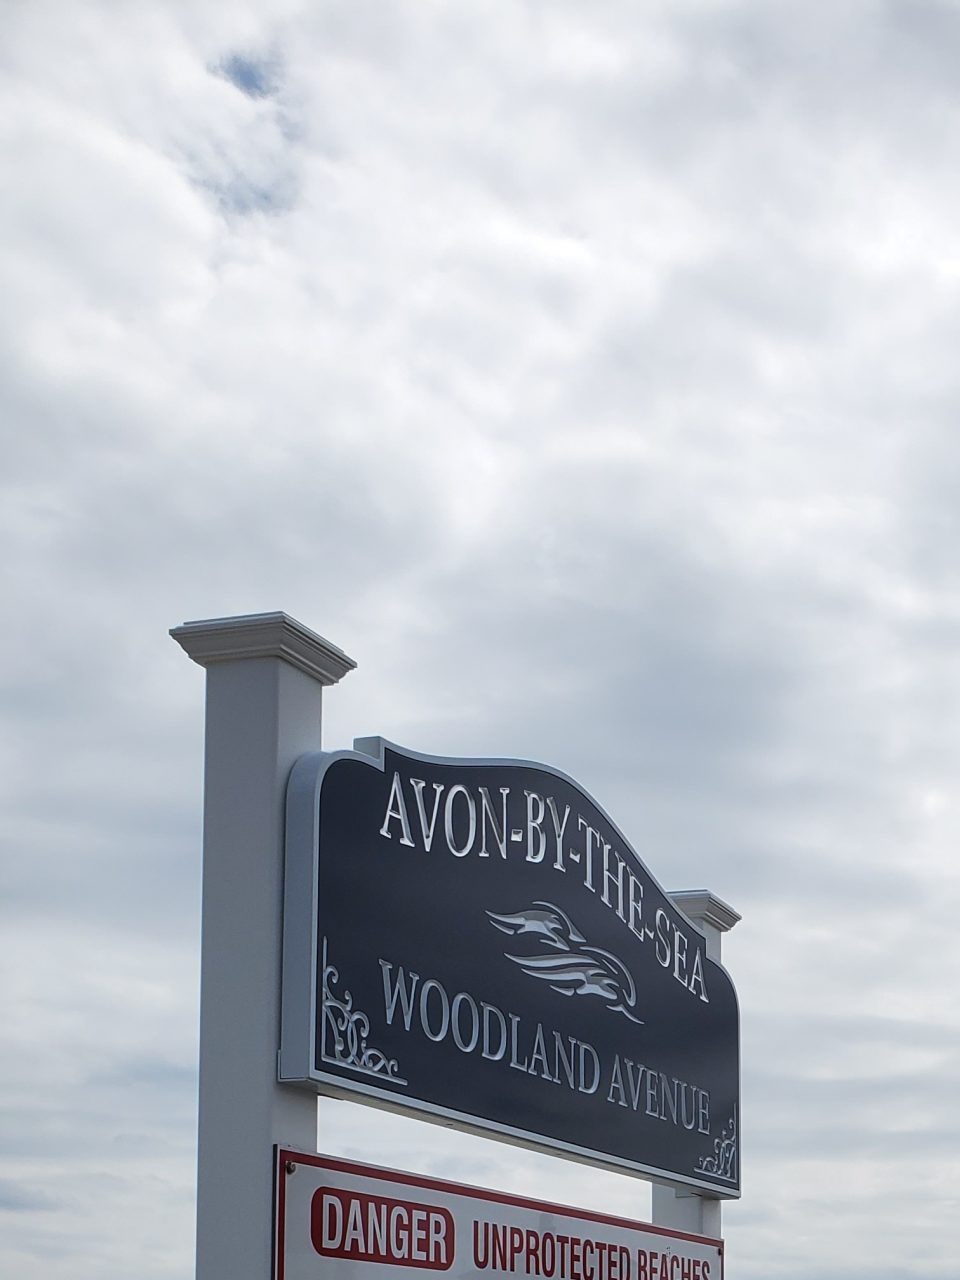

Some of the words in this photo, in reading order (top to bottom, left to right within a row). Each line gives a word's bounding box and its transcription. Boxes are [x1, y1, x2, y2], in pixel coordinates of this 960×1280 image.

[379, 771, 709, 1003] AVON-BY-THE-SEA
[379, 958, 601, 1095] WOODLAND
[606, 1053, 711, 1135] AVENUE
[321, 1194, 447, 1264] DANGER
